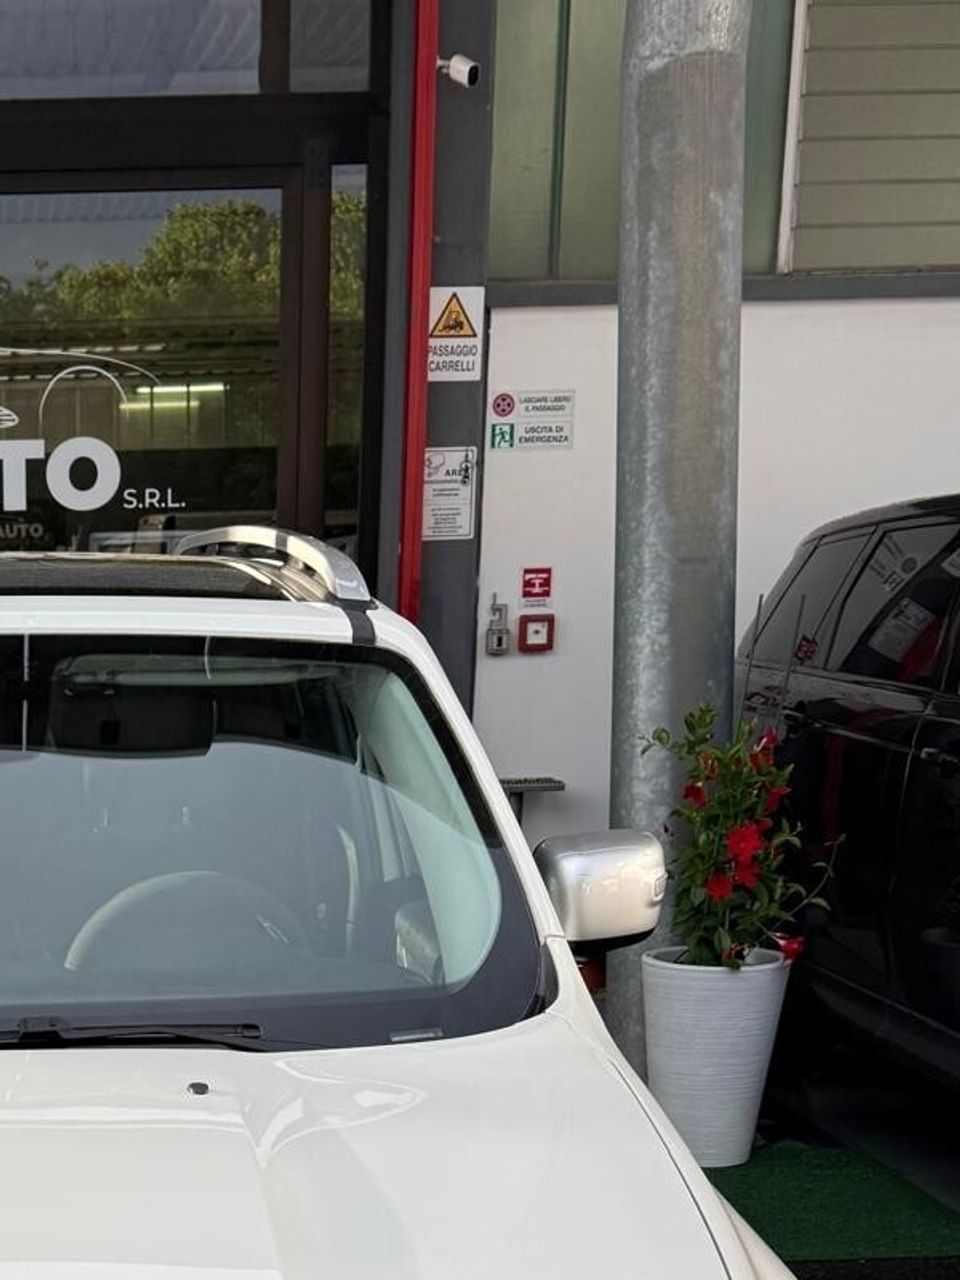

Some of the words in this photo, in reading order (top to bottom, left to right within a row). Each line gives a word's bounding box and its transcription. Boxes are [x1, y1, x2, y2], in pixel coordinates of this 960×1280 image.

[429, 359, 475, 372] CARRELLI
[524, 425, 553, 434] USCITA
[555, 425, 564, 433] DI
[518, 434, 569, 443] EMERGENZA
[123, 488, 186, 509] S.R.L.
